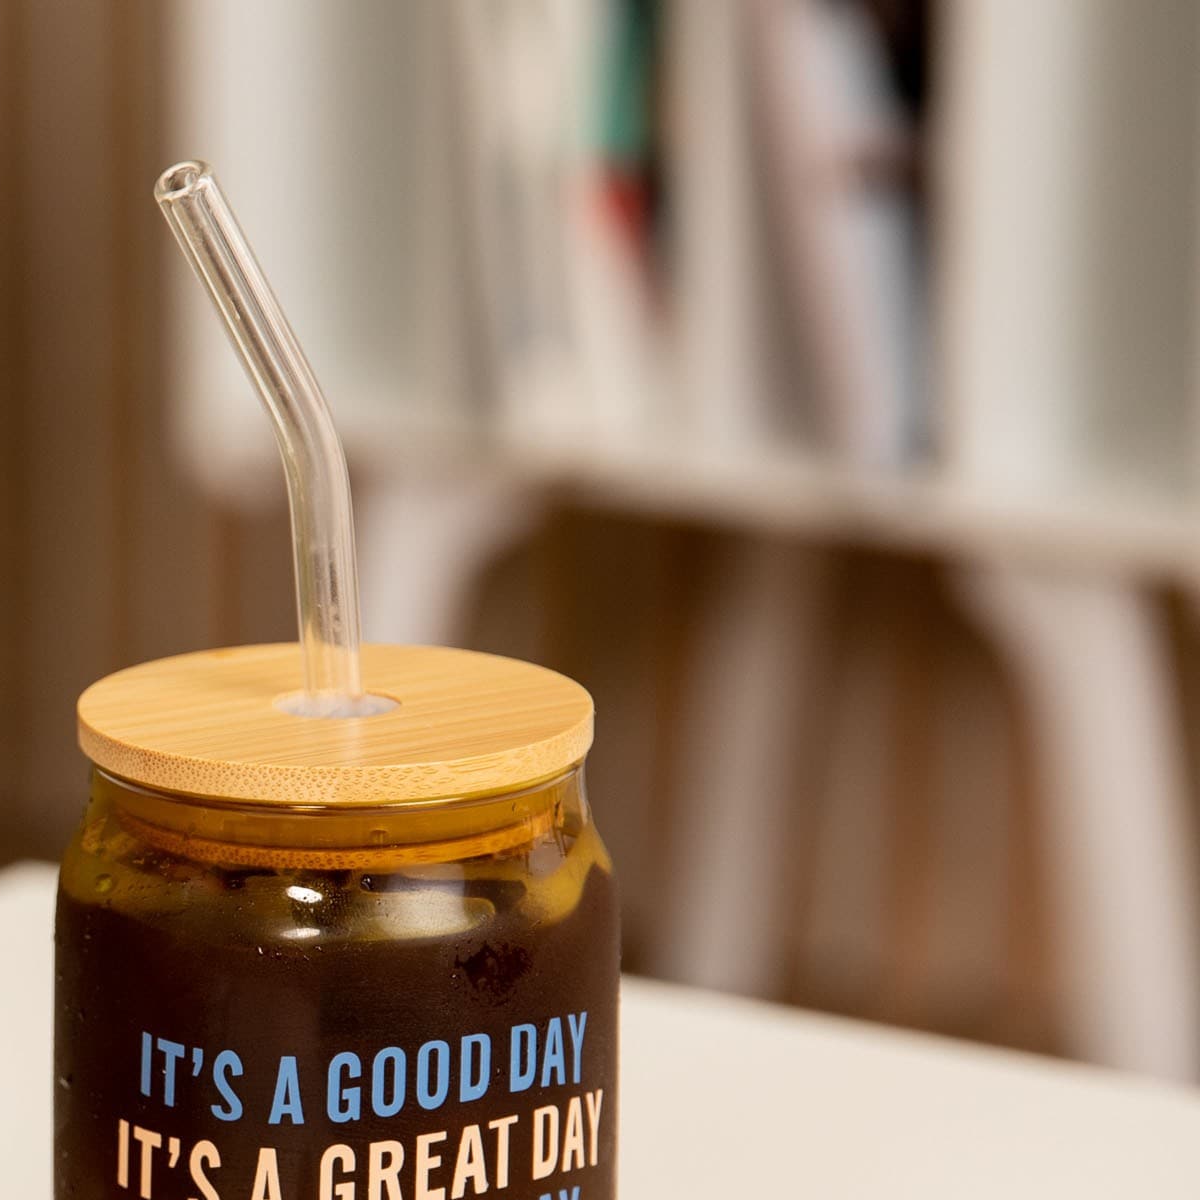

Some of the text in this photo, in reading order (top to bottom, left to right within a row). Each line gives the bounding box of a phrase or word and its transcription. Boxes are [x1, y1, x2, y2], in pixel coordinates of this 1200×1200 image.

[141, 1011, 589, 1125] IT'S A GOOD DAY
[532, 1089, 604, 1180] DAY
